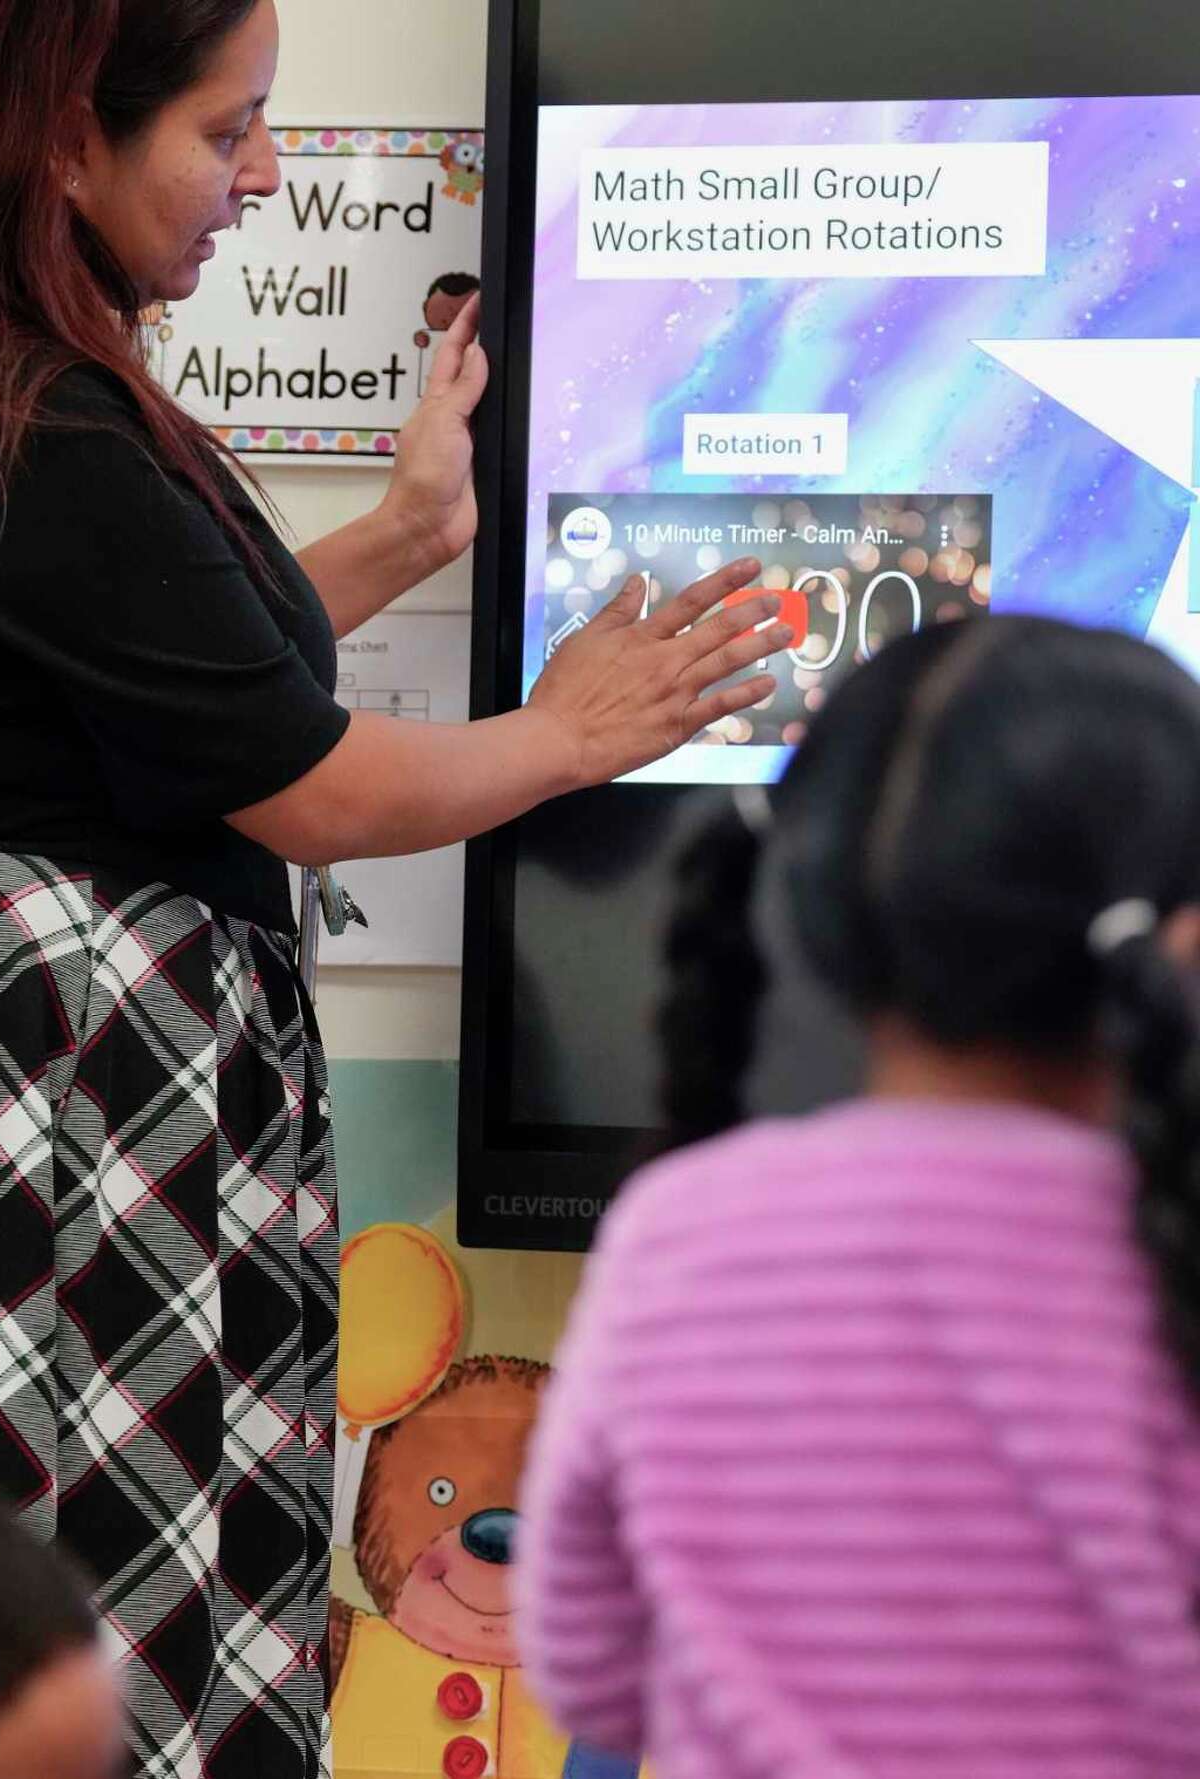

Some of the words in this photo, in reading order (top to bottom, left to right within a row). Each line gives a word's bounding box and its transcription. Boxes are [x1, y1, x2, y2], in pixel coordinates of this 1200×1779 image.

[287, 180, 434, 234] Word
[593, 168, 685, 202] Math
[697, 166, 800, 201] Small
[813, 165, 943, 208] Group/
[591, 218, 812, 253] Workstation
[825, 217, 1004, 251] Rotations
[241, 264, 348, 317] Wall
[174, 346, 407, 412] Alphabet
[696, 432, 803, 456] Rotation
[812, 433, 824, 455] 1
[623, 524, 649, 544] 10
[653, 523, 723, 545] Minute
[727, 523, 787, 545] Timer
[803, 523, 856, 545] Calm
